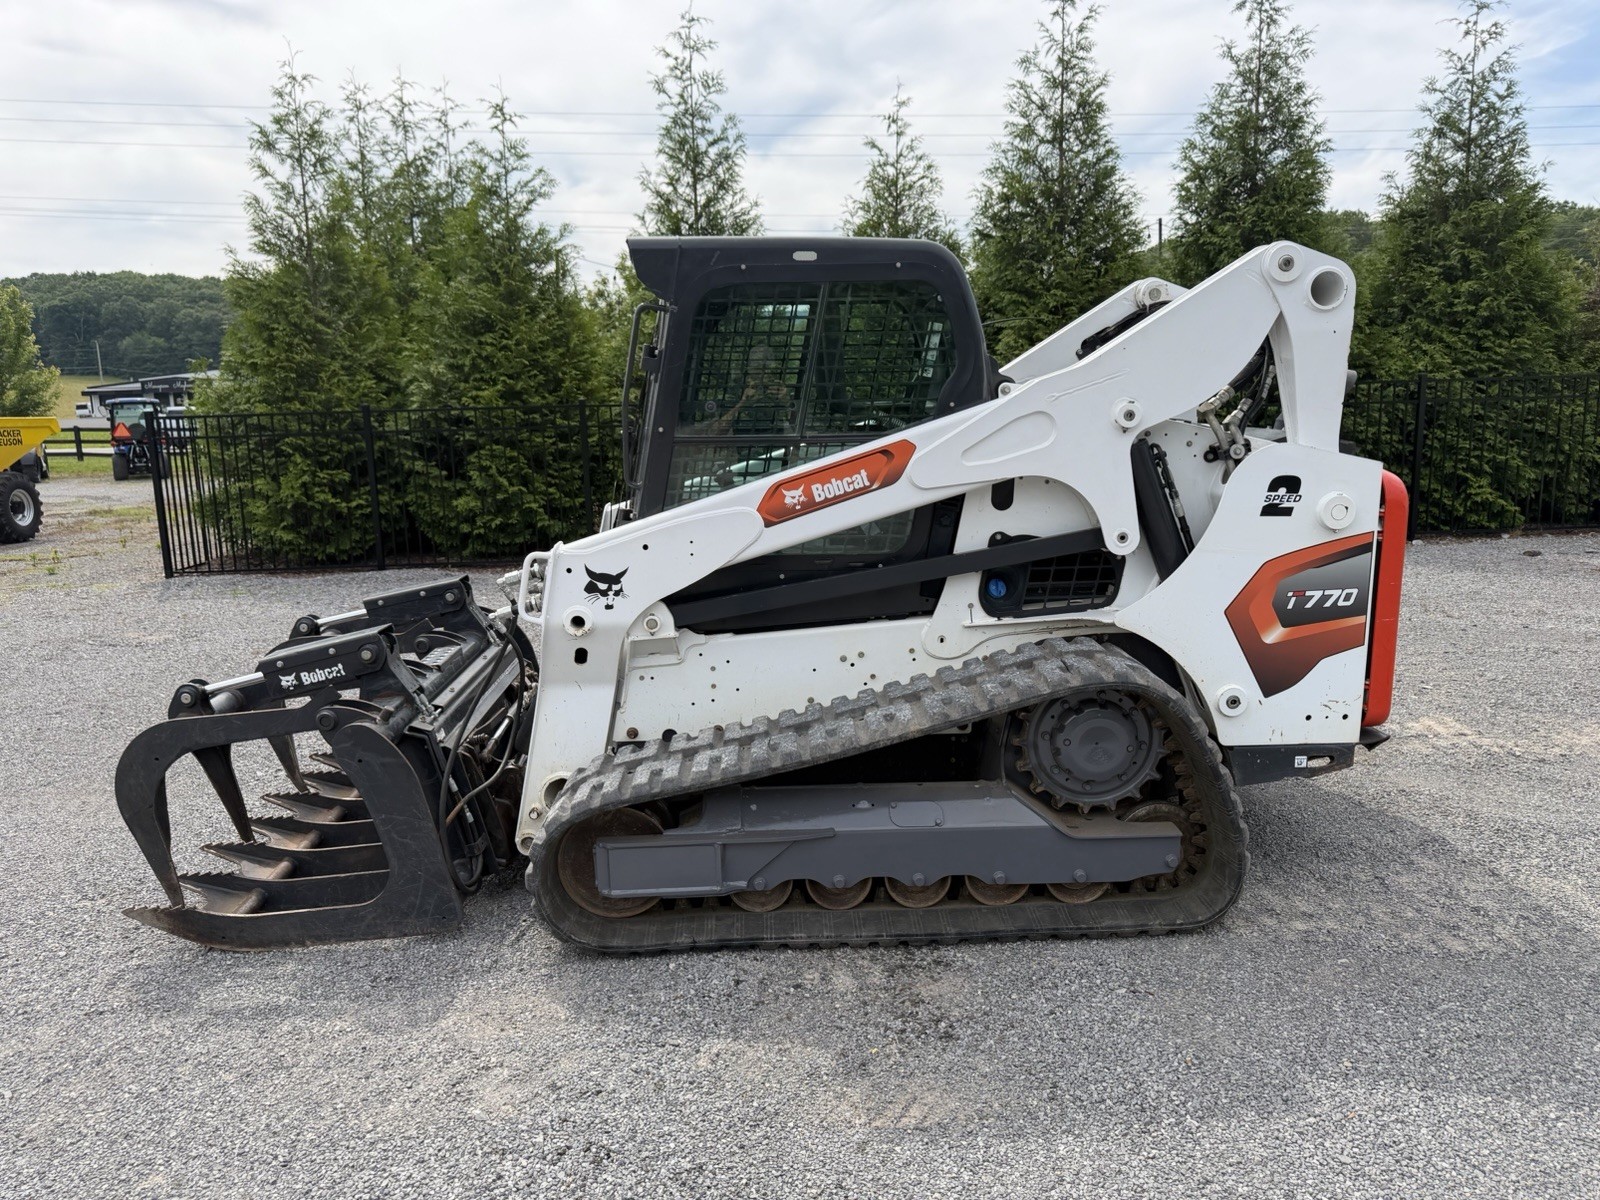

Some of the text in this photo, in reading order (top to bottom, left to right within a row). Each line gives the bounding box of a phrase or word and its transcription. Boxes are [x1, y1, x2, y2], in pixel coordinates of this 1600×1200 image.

[811, 469, 871, 502] Bobcat
[1260, 475, 1303, 517] 2 SPEED
[1286, 588, 1359, 610] T770
[300, 663, 346, 685] Bobcat
